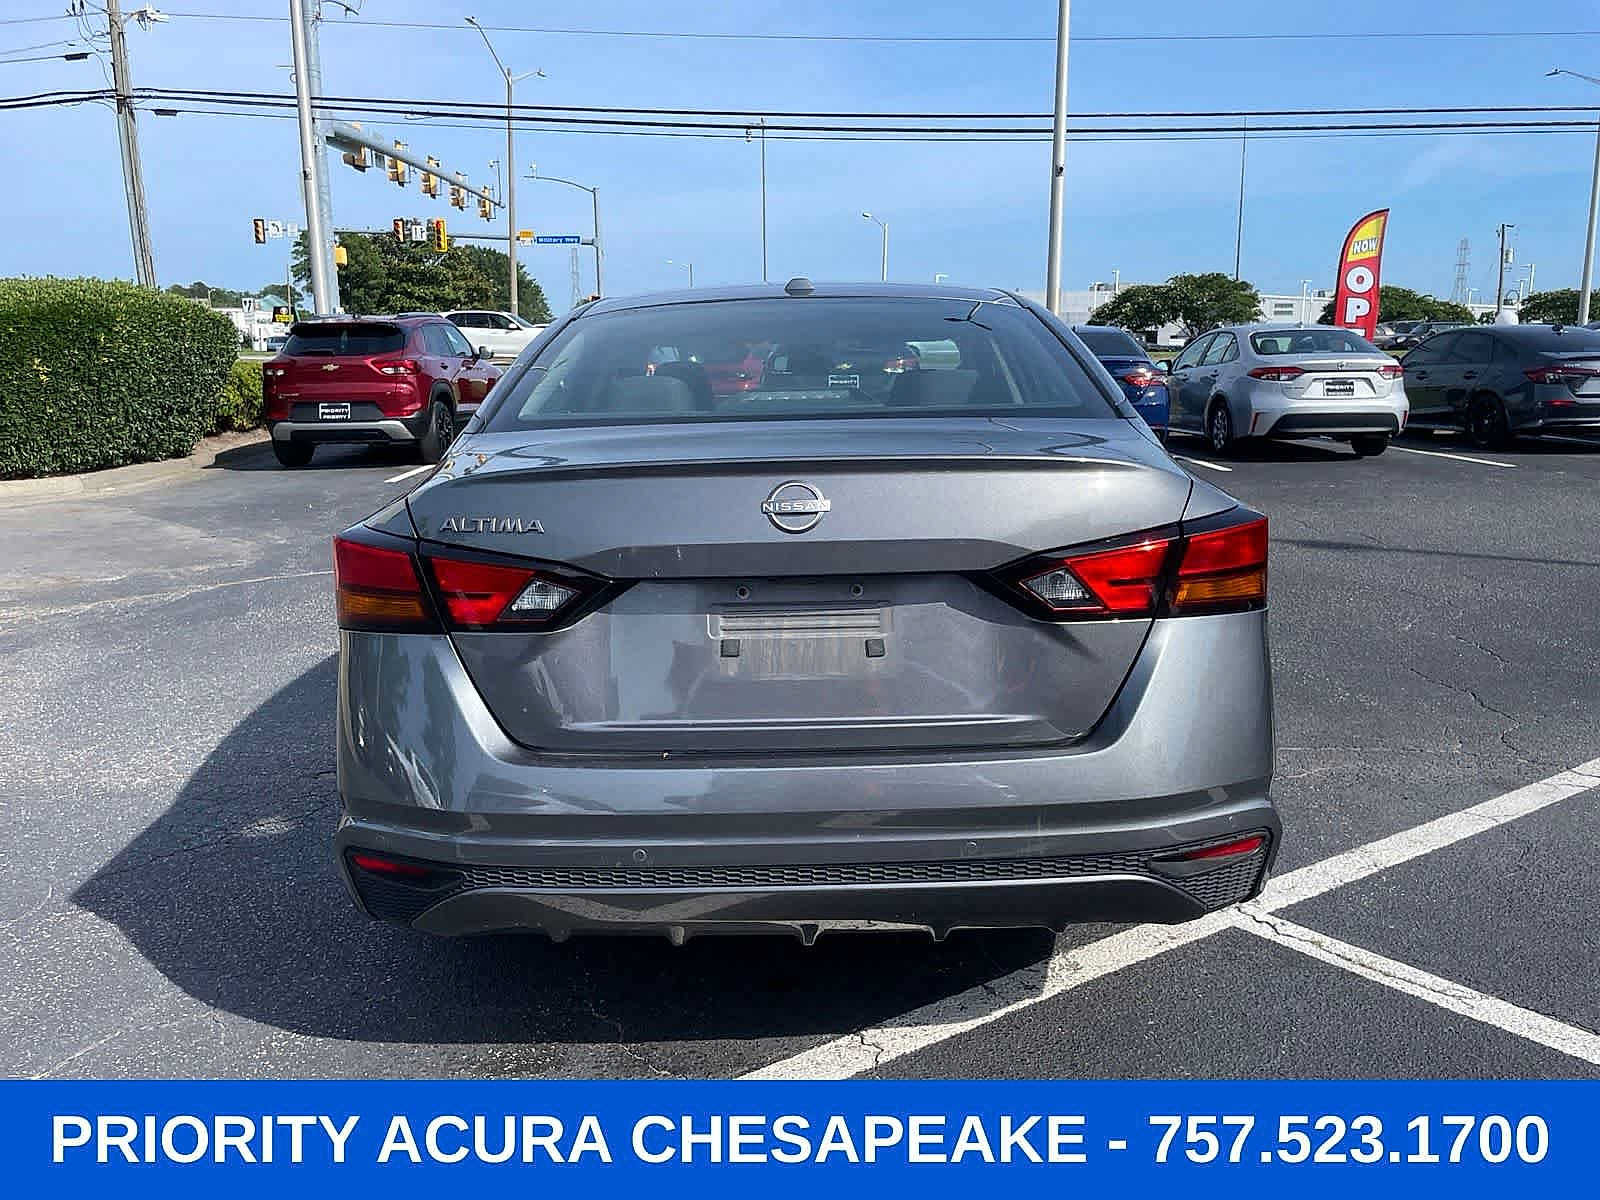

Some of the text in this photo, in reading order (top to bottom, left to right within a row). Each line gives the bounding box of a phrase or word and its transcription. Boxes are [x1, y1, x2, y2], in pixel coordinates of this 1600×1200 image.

[1353, 238, 1377, 255] NOW
[1345, 265, 1375, 337] OP
[762, 502, 829, 512] NISSAN
[440, 517, 545, 533] ALTIMA
